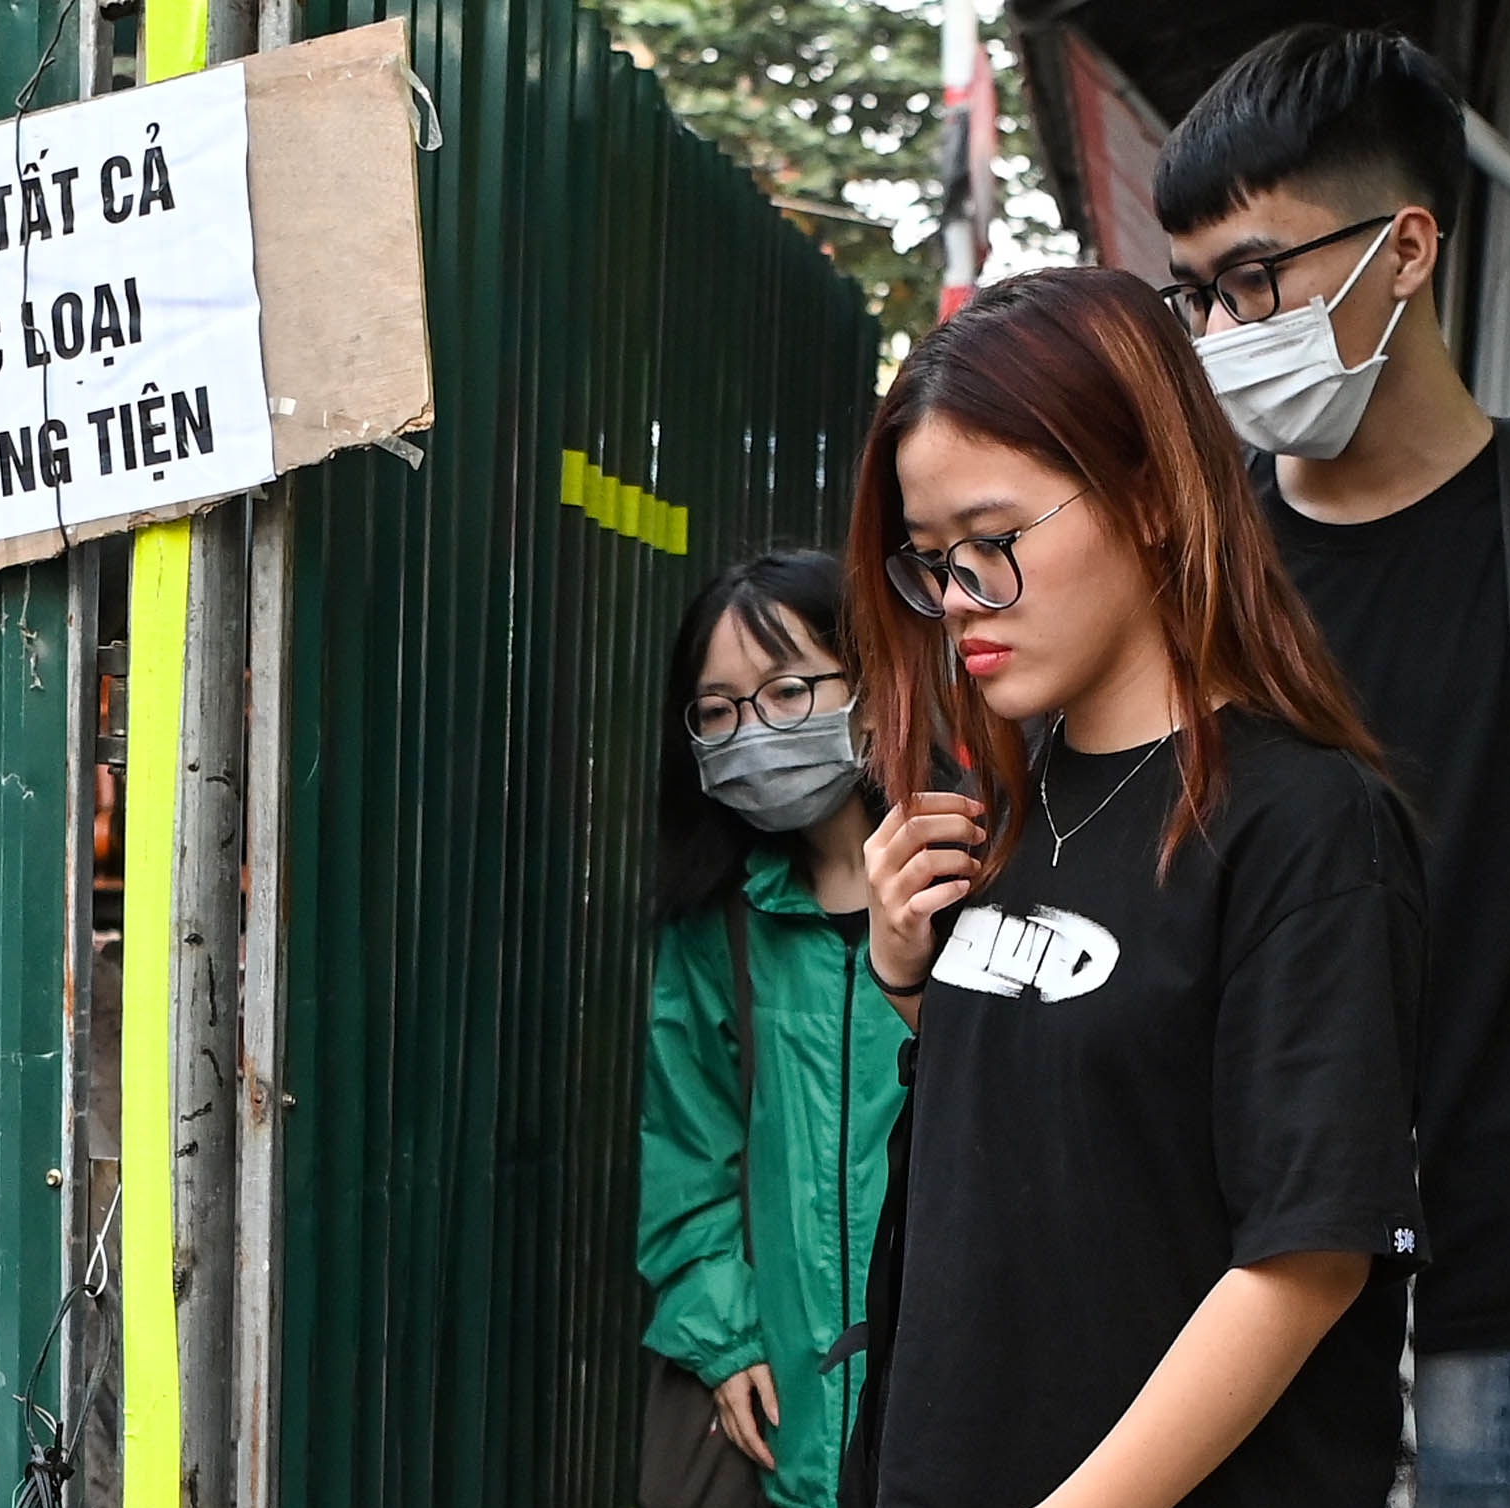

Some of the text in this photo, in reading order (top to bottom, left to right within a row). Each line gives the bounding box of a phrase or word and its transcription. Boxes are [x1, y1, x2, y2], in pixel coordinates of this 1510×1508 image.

[101, 123, 176, 224] CẢ
[24, 277, 142, 368] LOẠI
[87, 382, 214, 481] TIỆN
